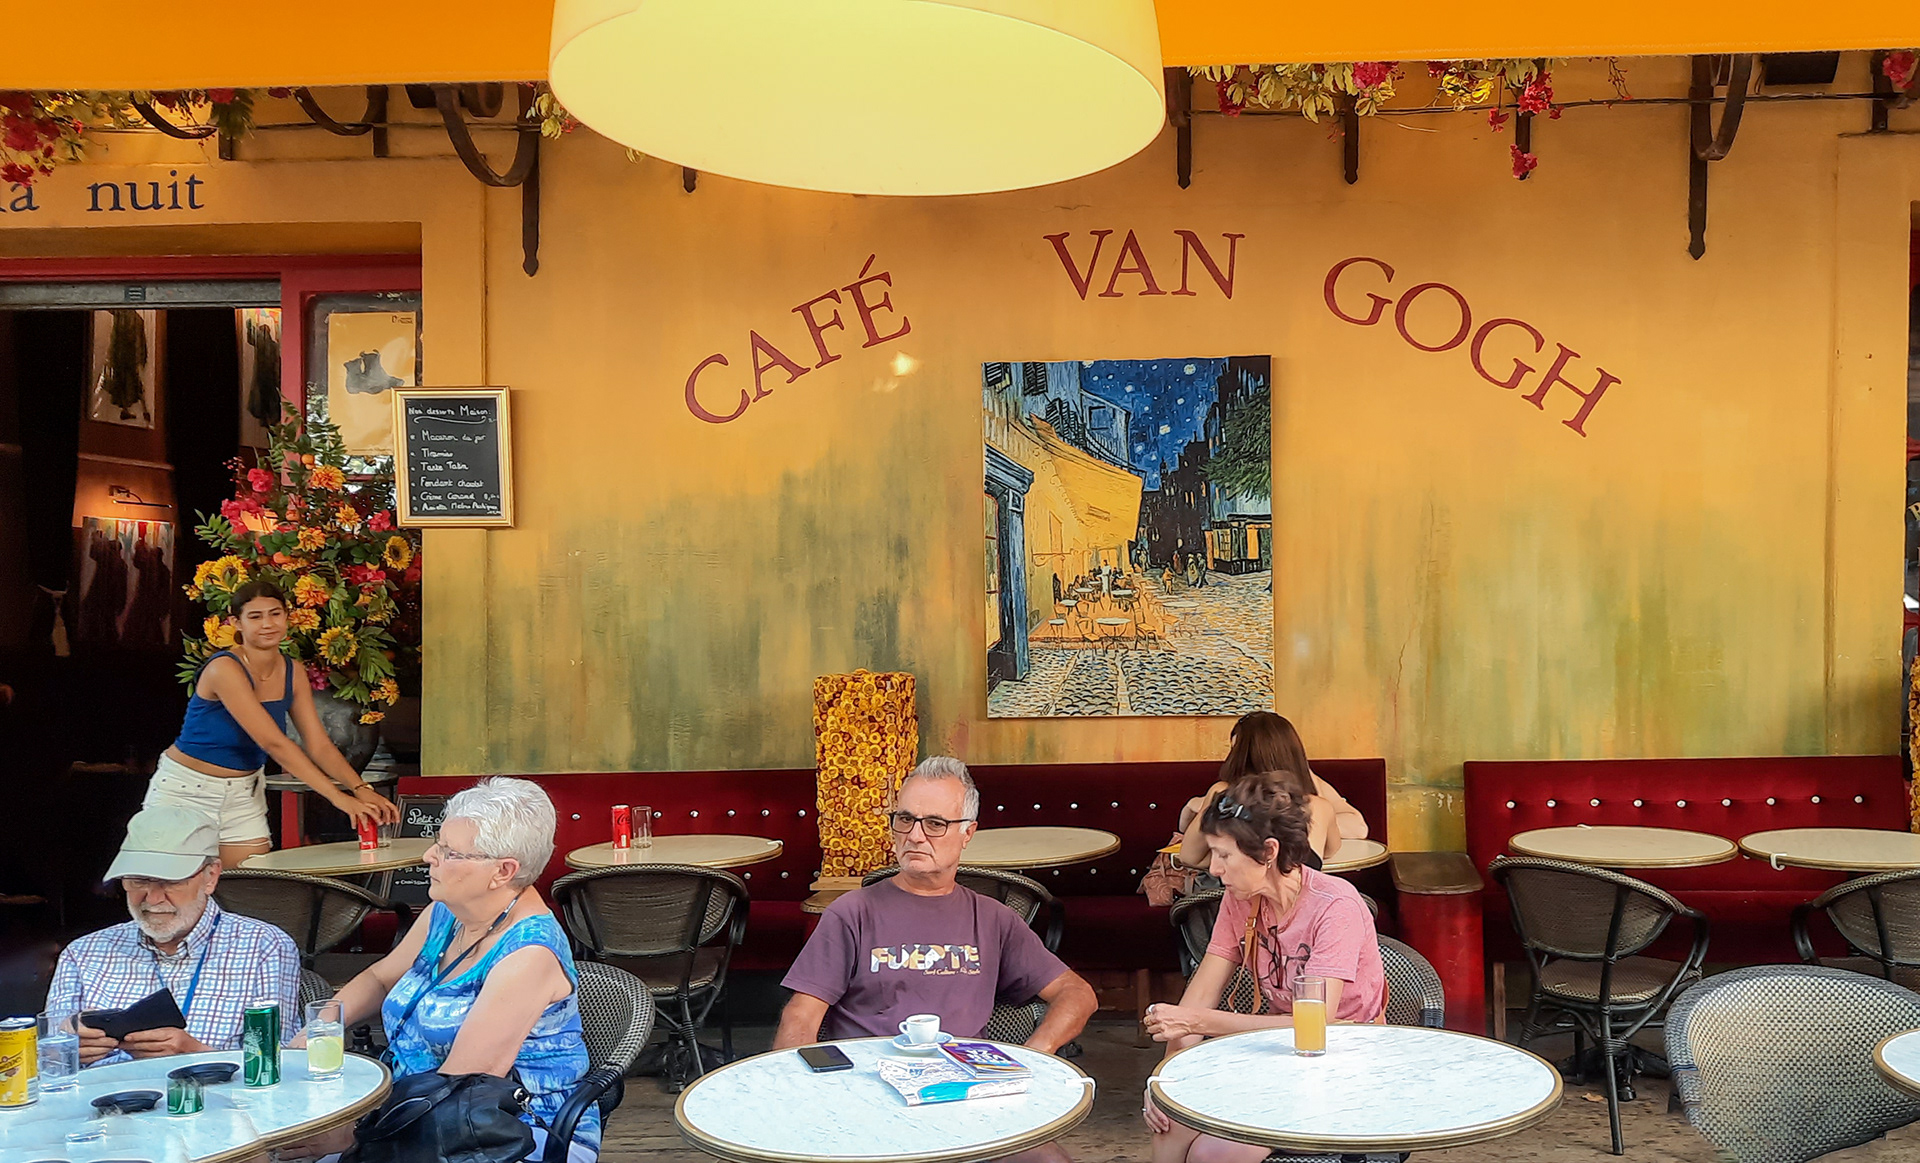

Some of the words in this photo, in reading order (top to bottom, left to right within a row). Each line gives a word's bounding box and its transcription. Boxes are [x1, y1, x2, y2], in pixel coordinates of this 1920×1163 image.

[86, 170, 205, 212] nuit
[684, 253, 912, 425] CAFÉ
[1043, 229, 1246, 302] VAN
[1323, 256, 1622, 438] GOGH
[420, 476, 453, 487] Fondant
